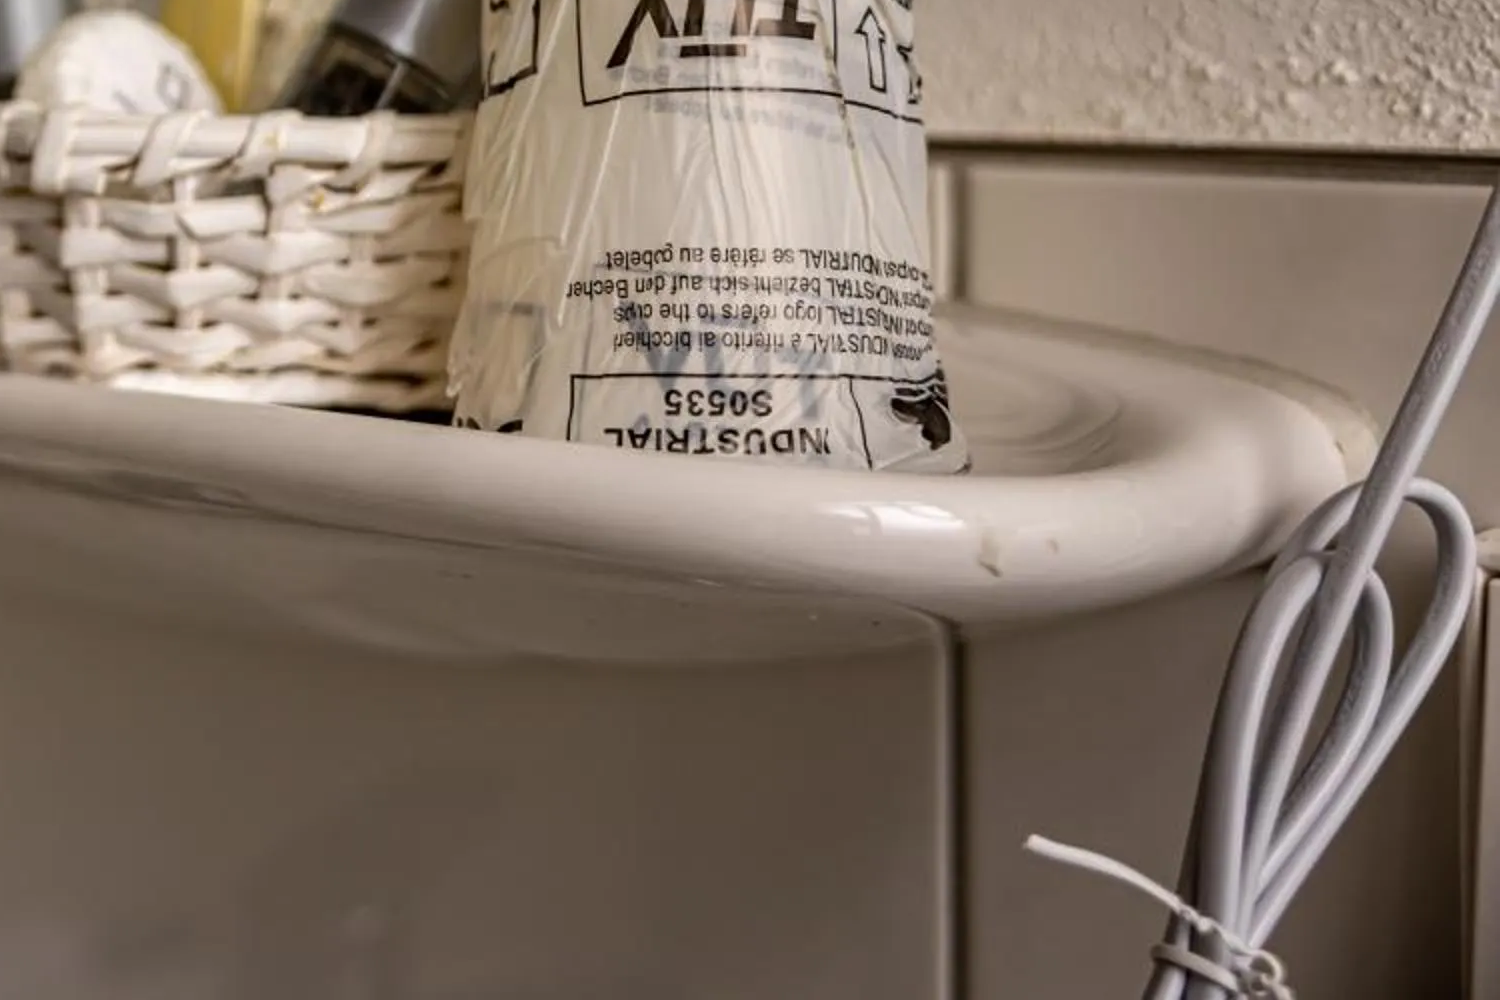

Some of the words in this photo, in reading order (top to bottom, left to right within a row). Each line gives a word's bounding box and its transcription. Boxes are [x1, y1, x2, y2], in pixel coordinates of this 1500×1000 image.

[605, 244, 673, 271] gobelet
[680, 247, 703, 267] au
[772, 247, 795, 266] se
[799, 249, 883, 275] NDUTRIAL
[566, 278, 629, 304] Becher
[670, 275, 703, 295] auf
[707, 276, 749, 295] sich
[754, 276, 821, 297] bezieht
[612, 301, 653, 326] cups
[659, 303, 690, 325] the
[697, 303, 715, 325] to
[721, 303, 777, 326] refers
[784, 299, 822, 325] logo
[826, 304, 903, 335] INUSTRAL
[612, 330, 692, 354] bicchieri
[698, 331, 717, 353] ai
[722, 331, 785, 354] riferito
[790, 332, 801, 354] è
[808, 332, 889, 356] IDUSIAL
[662, 389, 773, 417] S0535
[603, 427, 830, 456] INDUSTRIAL
